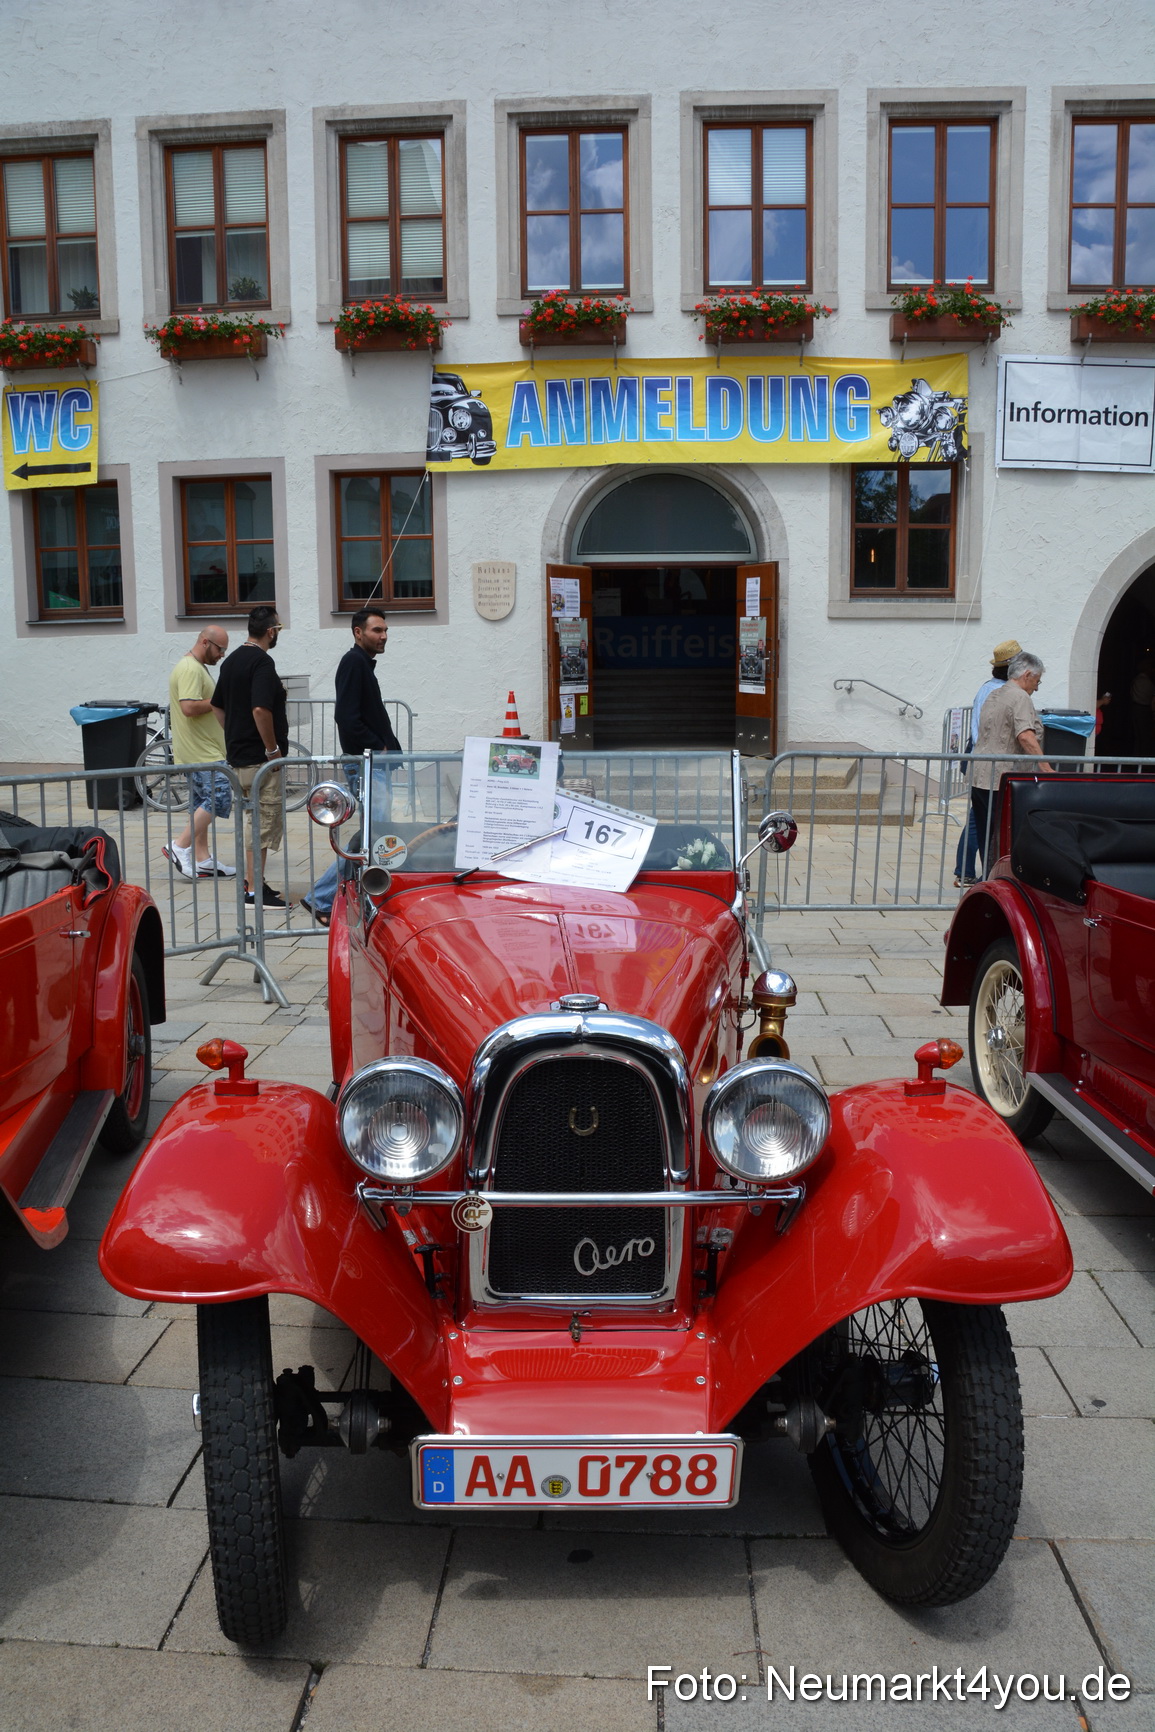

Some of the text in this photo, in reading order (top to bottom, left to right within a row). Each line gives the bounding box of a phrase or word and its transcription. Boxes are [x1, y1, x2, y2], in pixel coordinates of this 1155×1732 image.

[5, 387, 92, 454] WC
[505, 374, 871, 448] ANMELDUNG
[1009, 401, 1149, 427] Information
[584, 820, 627, 847] 167
[574, 1237, 655, 1276] Aero
[433, 1482, 444, 1493] D
[465, 1455, 536, 1497] AA
